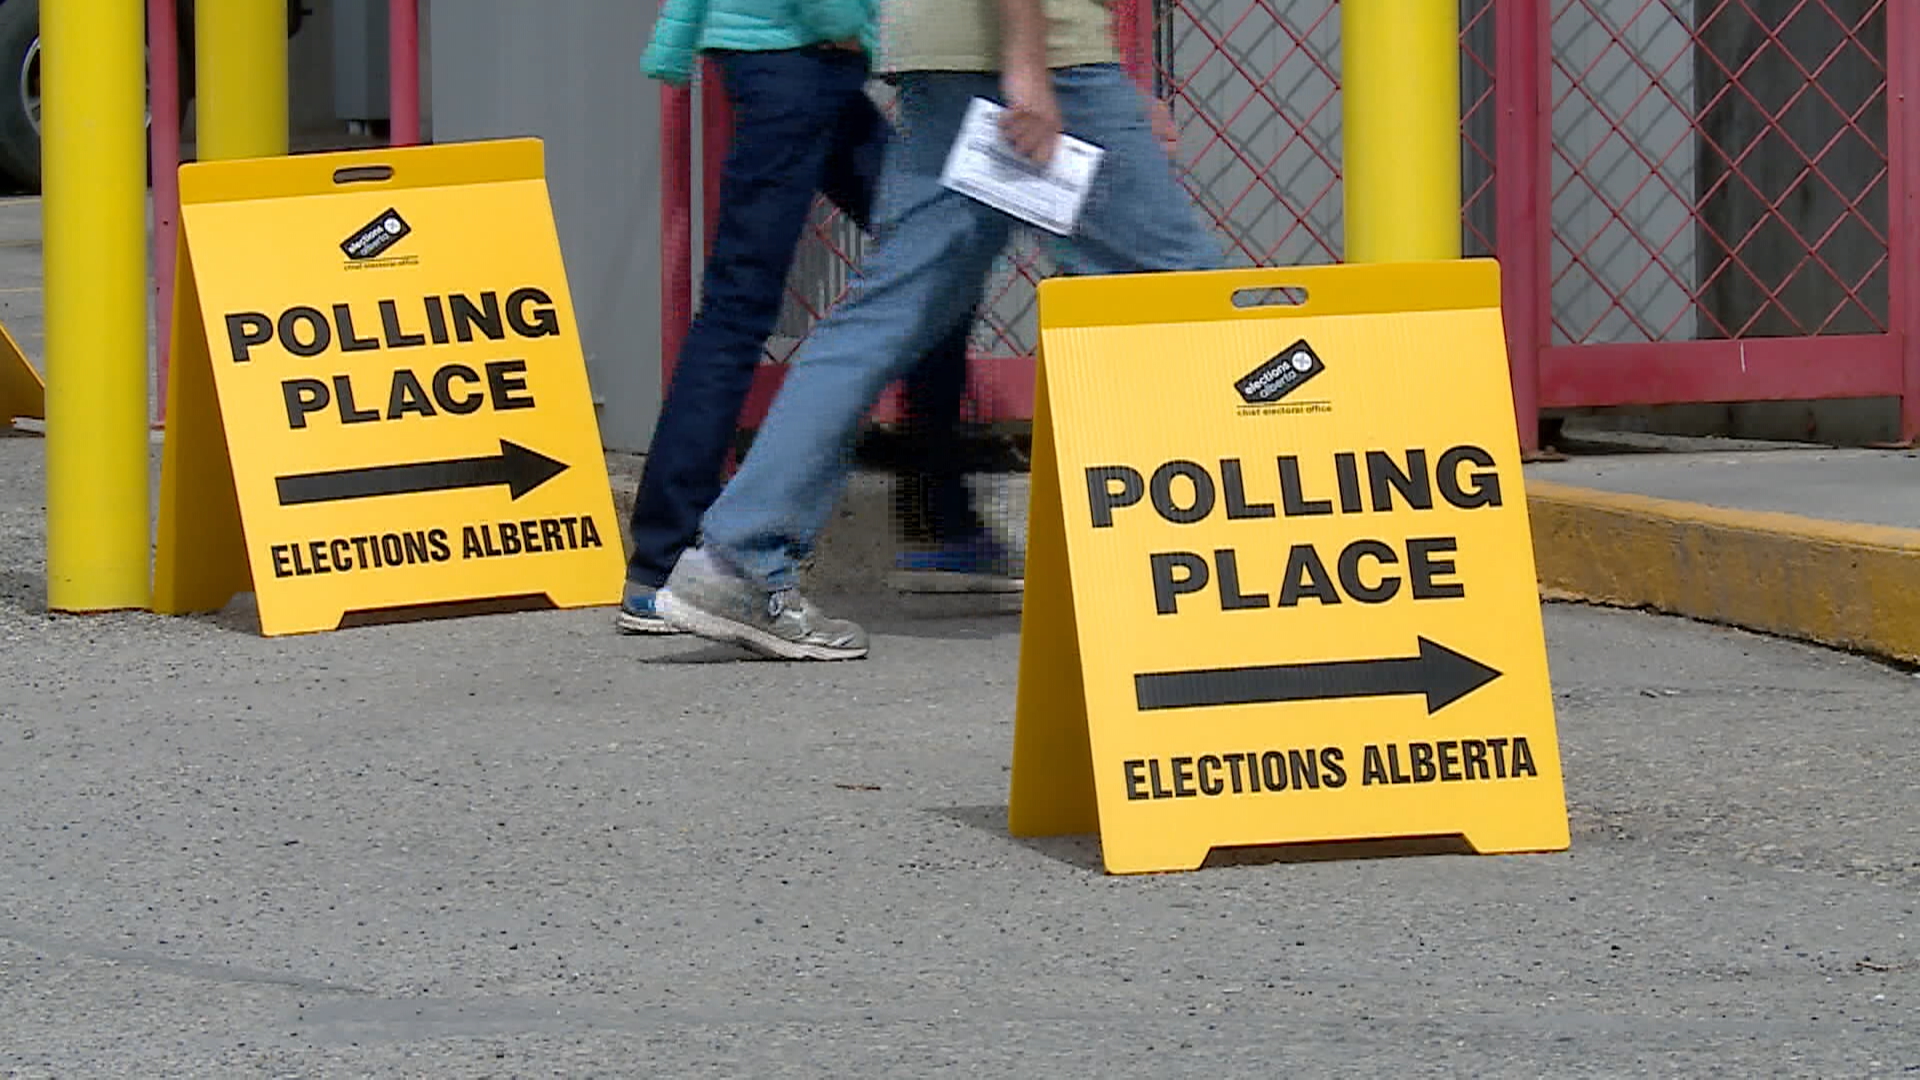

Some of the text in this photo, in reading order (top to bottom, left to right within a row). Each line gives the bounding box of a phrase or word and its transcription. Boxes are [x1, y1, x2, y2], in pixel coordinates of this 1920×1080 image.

[347, 225, 384, 253] elections
[225, 287, 559, 362] POLLING
[281, 360, 535, 429] PLACE
[1244, 361, 1291, 393] elections
[1259, 370, 1297, 398] alberta
[1237, 405, 1332, 417] chief electoral office
[1085, 446, 1502, 528] POLLING
[271, 516, 602, 577] ELECTIONS ALBERTA
[1150, 537, 1464, 615] PLACE
[1124, 737, 1537, 800] ELECTIONS ALBERTA
